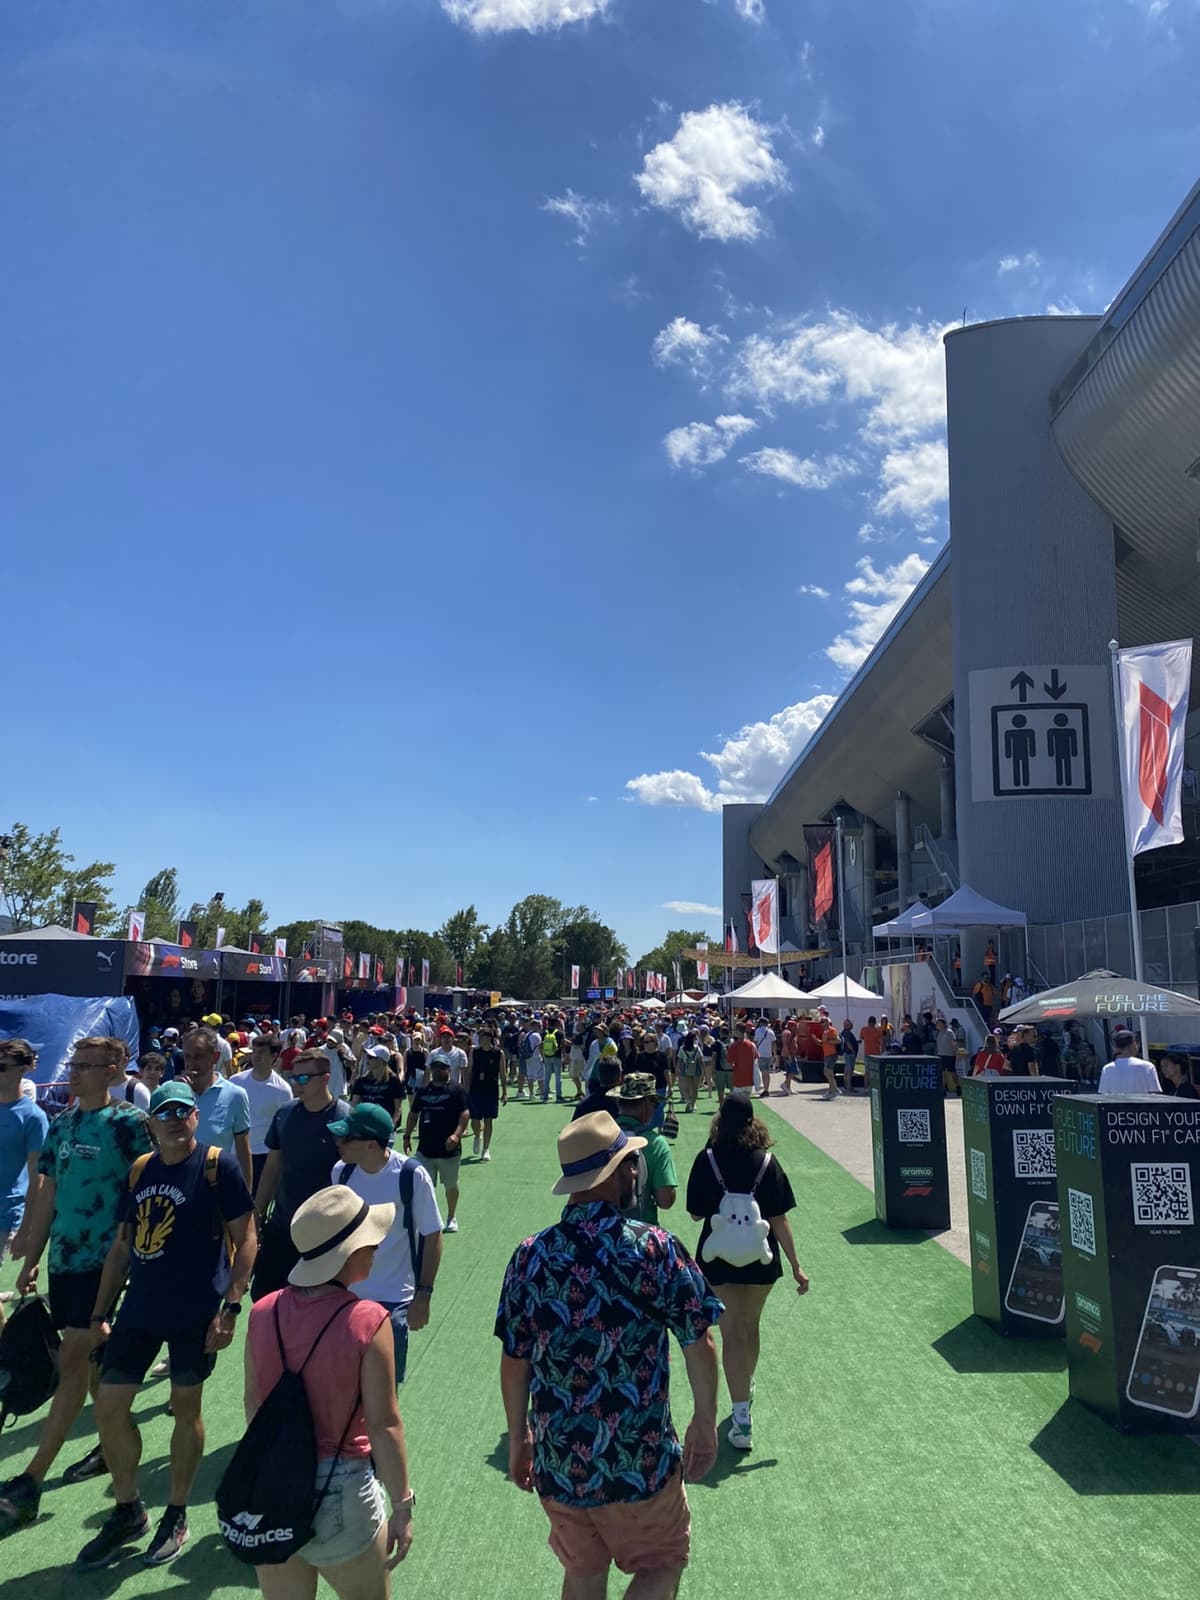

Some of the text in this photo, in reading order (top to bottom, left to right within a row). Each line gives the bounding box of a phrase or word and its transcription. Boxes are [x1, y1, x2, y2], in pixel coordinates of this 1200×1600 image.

[180, 956, 199, 970] Store
[1095, 993, 1168, 1003] FUEL THE
[1096, 1002, 1169, 1013] FUTURE
[885, 1064, 912, 1075] FUEL
[915, 1064, 937, 1075] THE
[885, 1076, 937, 1089] FUTURE
[994, 1090, 1036, 1101] DESIGN
[995, 1103, 1025, 1115] OWN
[1056, 1107, 1077, 1129] FUEL
[1077, 1111, 1095, 1134] THE
[1107, 1111, 1160, 1126] DESIGN
[1108, 1129, 1146, 1144] OWN
[1057, 1129, 1097, 1160] FUTURE
[136, 1184, 186, 1206] BUEN CAMINO
